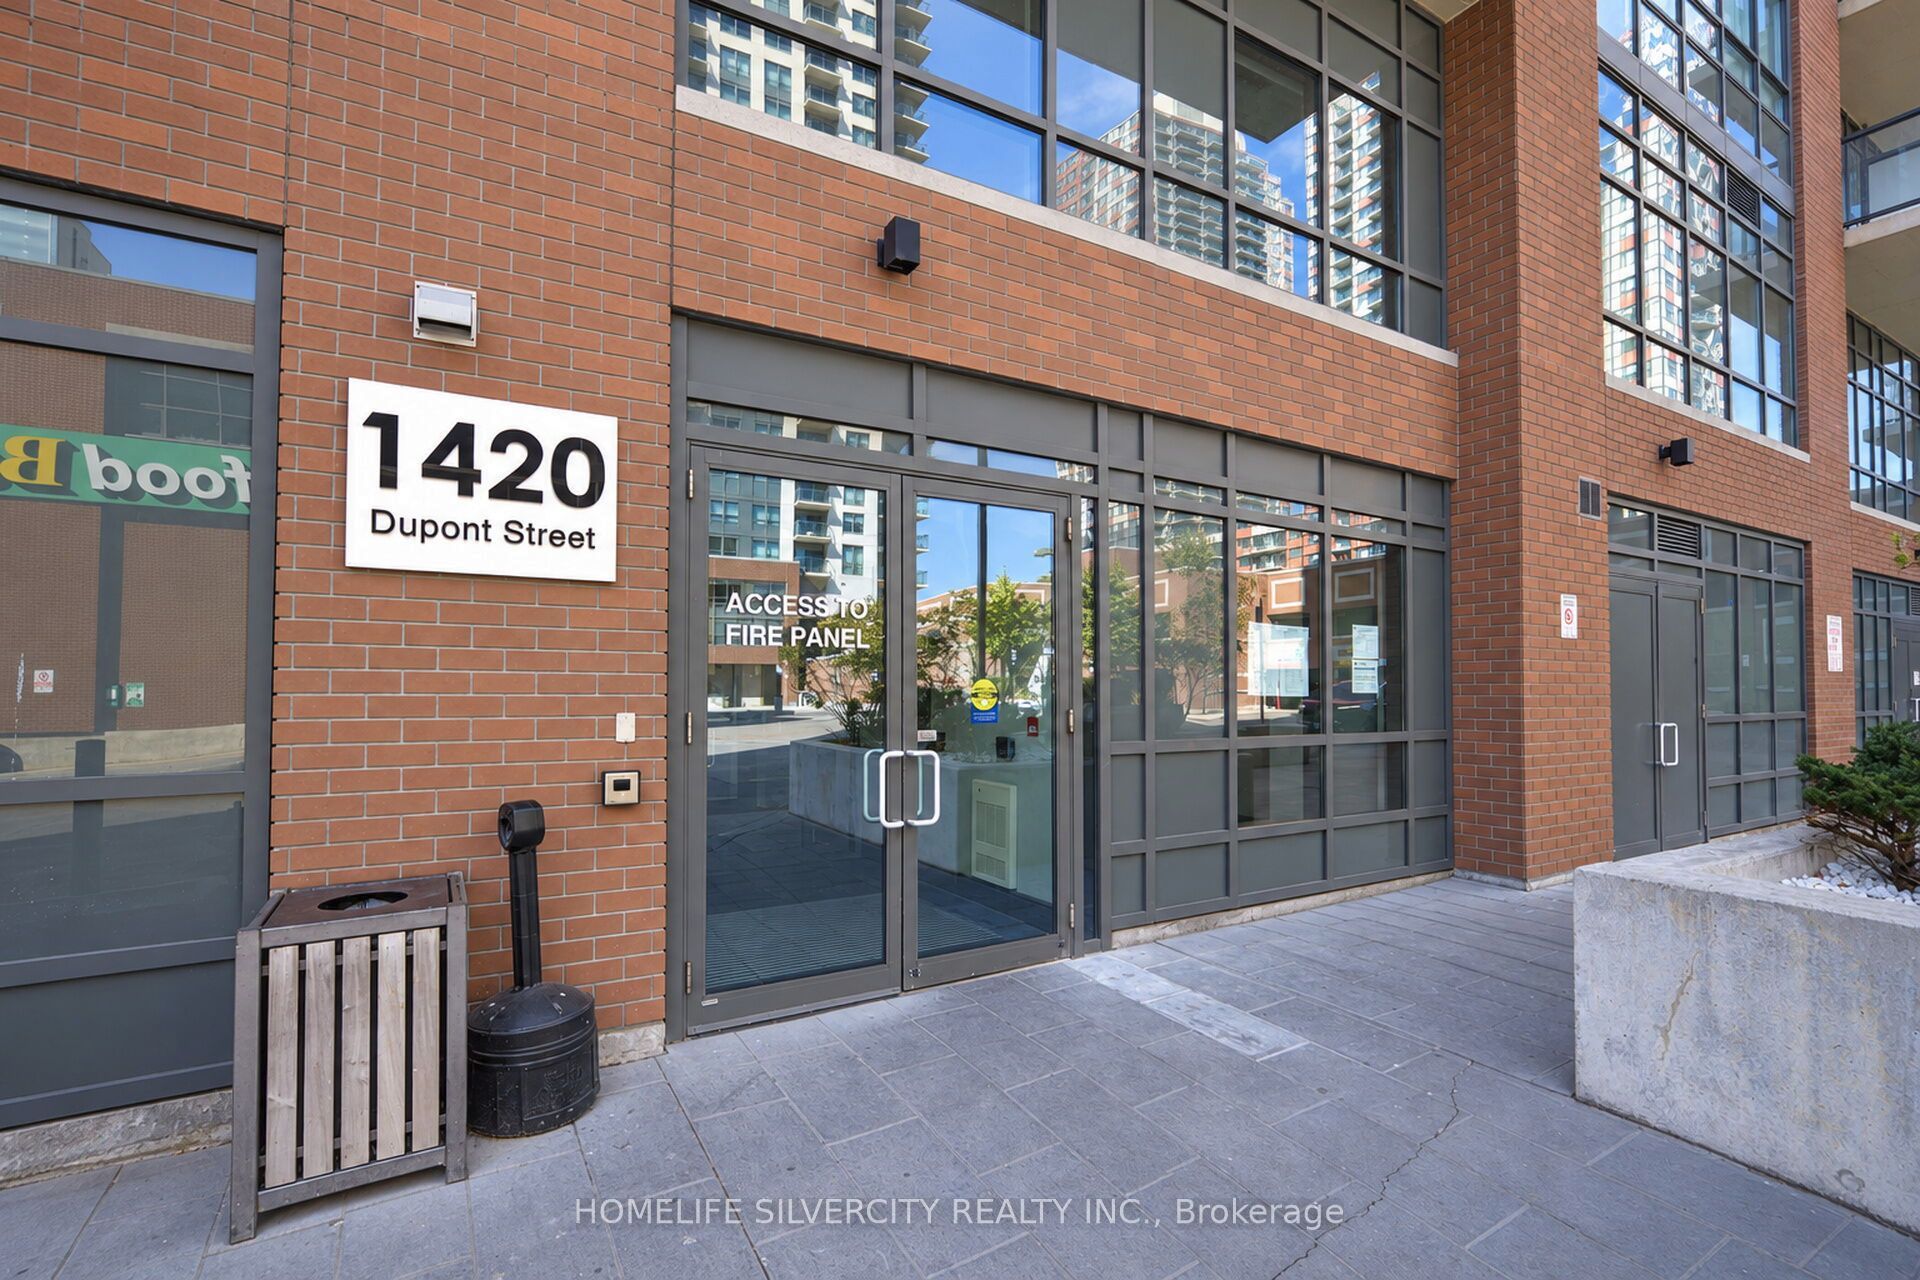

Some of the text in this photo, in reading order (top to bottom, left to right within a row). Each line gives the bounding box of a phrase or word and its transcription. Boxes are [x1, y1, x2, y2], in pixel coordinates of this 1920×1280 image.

[363, 412, 605, 508] 1420
[371, 508, 596, 550] Dupont Street
[725, 592, 868, 619] ACCESS TO
[725, 623, 870, 649] FIRE PANEL
